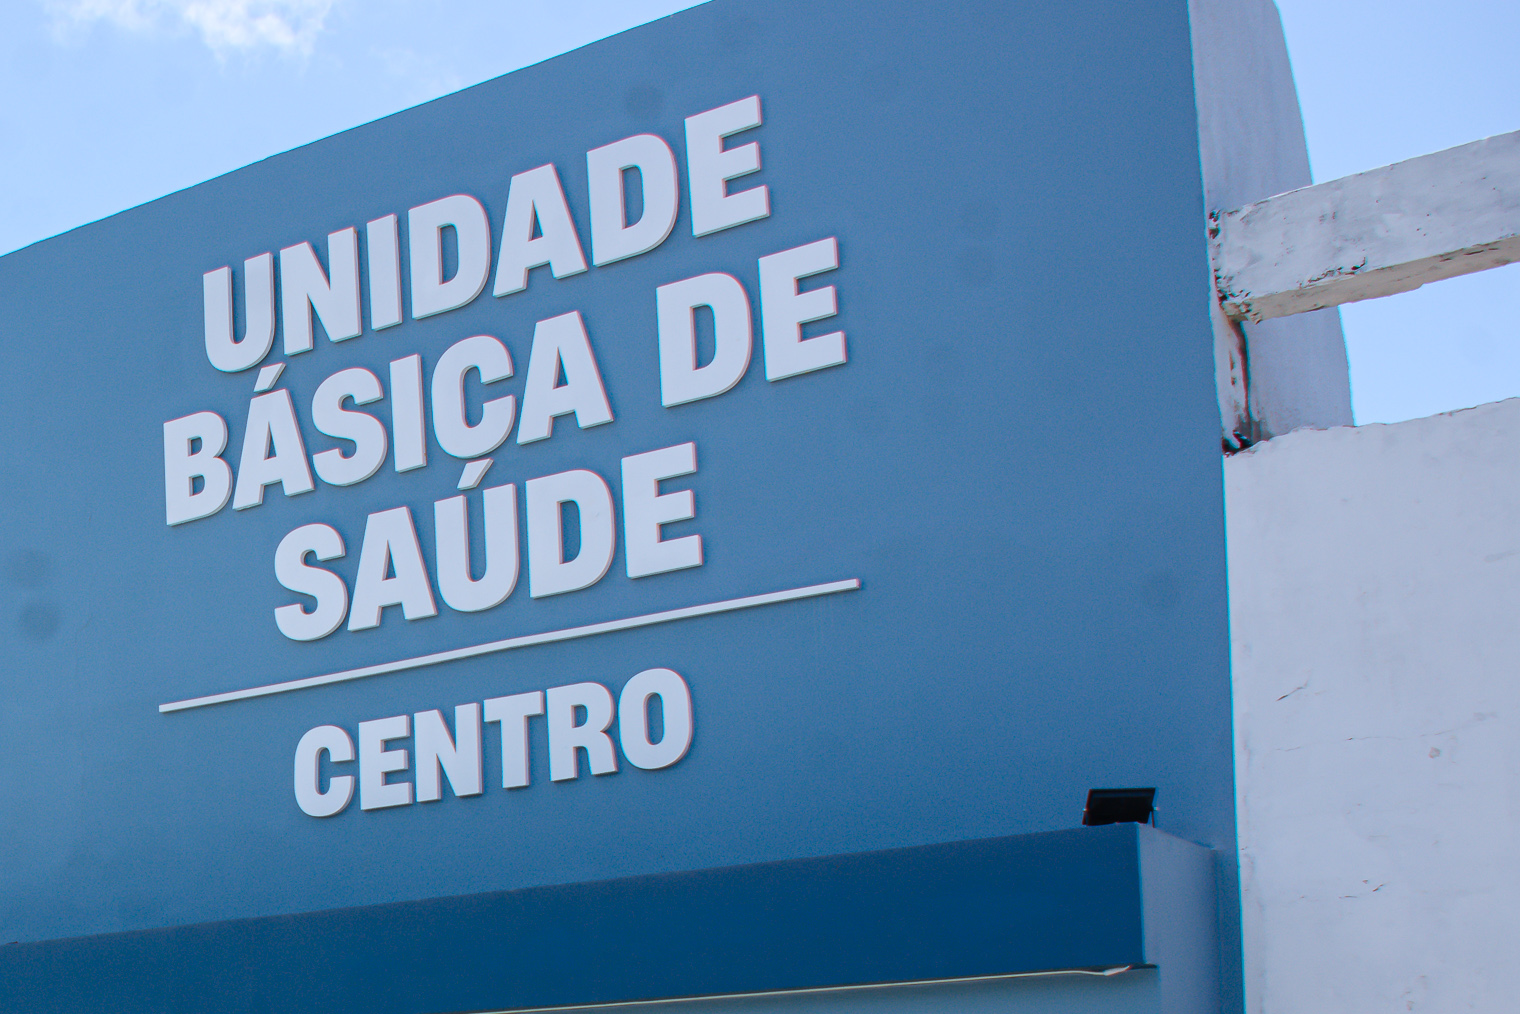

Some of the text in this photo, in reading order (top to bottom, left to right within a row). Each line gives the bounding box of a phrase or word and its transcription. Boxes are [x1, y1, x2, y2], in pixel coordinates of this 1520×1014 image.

[202, 94, 771, 374] UNIDADE
[162, 236, 847, 528] BÁSICA DE
[273, 441, 704, 642] SAÚDE
[293, 667, 695, 818] CENTRO
